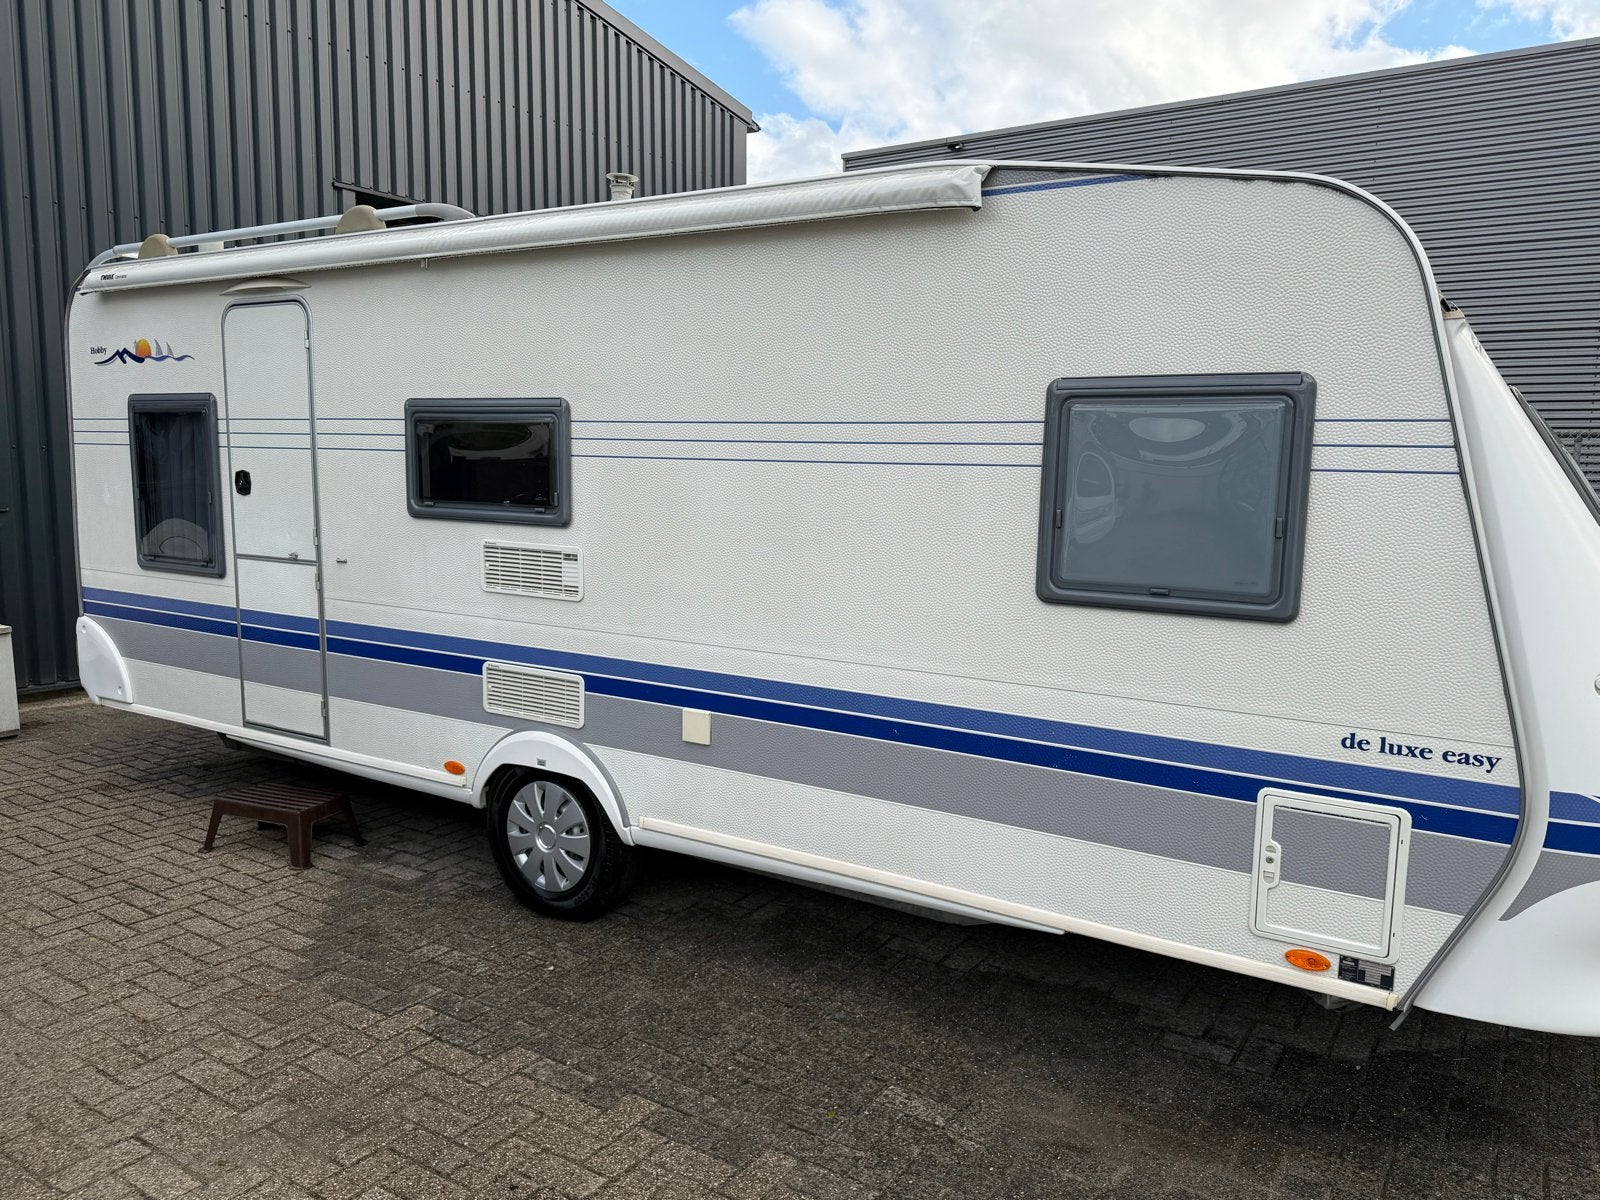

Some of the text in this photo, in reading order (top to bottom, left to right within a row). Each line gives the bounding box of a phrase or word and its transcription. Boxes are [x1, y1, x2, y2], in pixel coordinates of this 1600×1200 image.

[90, 346, 107, 355] Hobby
[1340, 732, 1502, 774] de luxe easy
